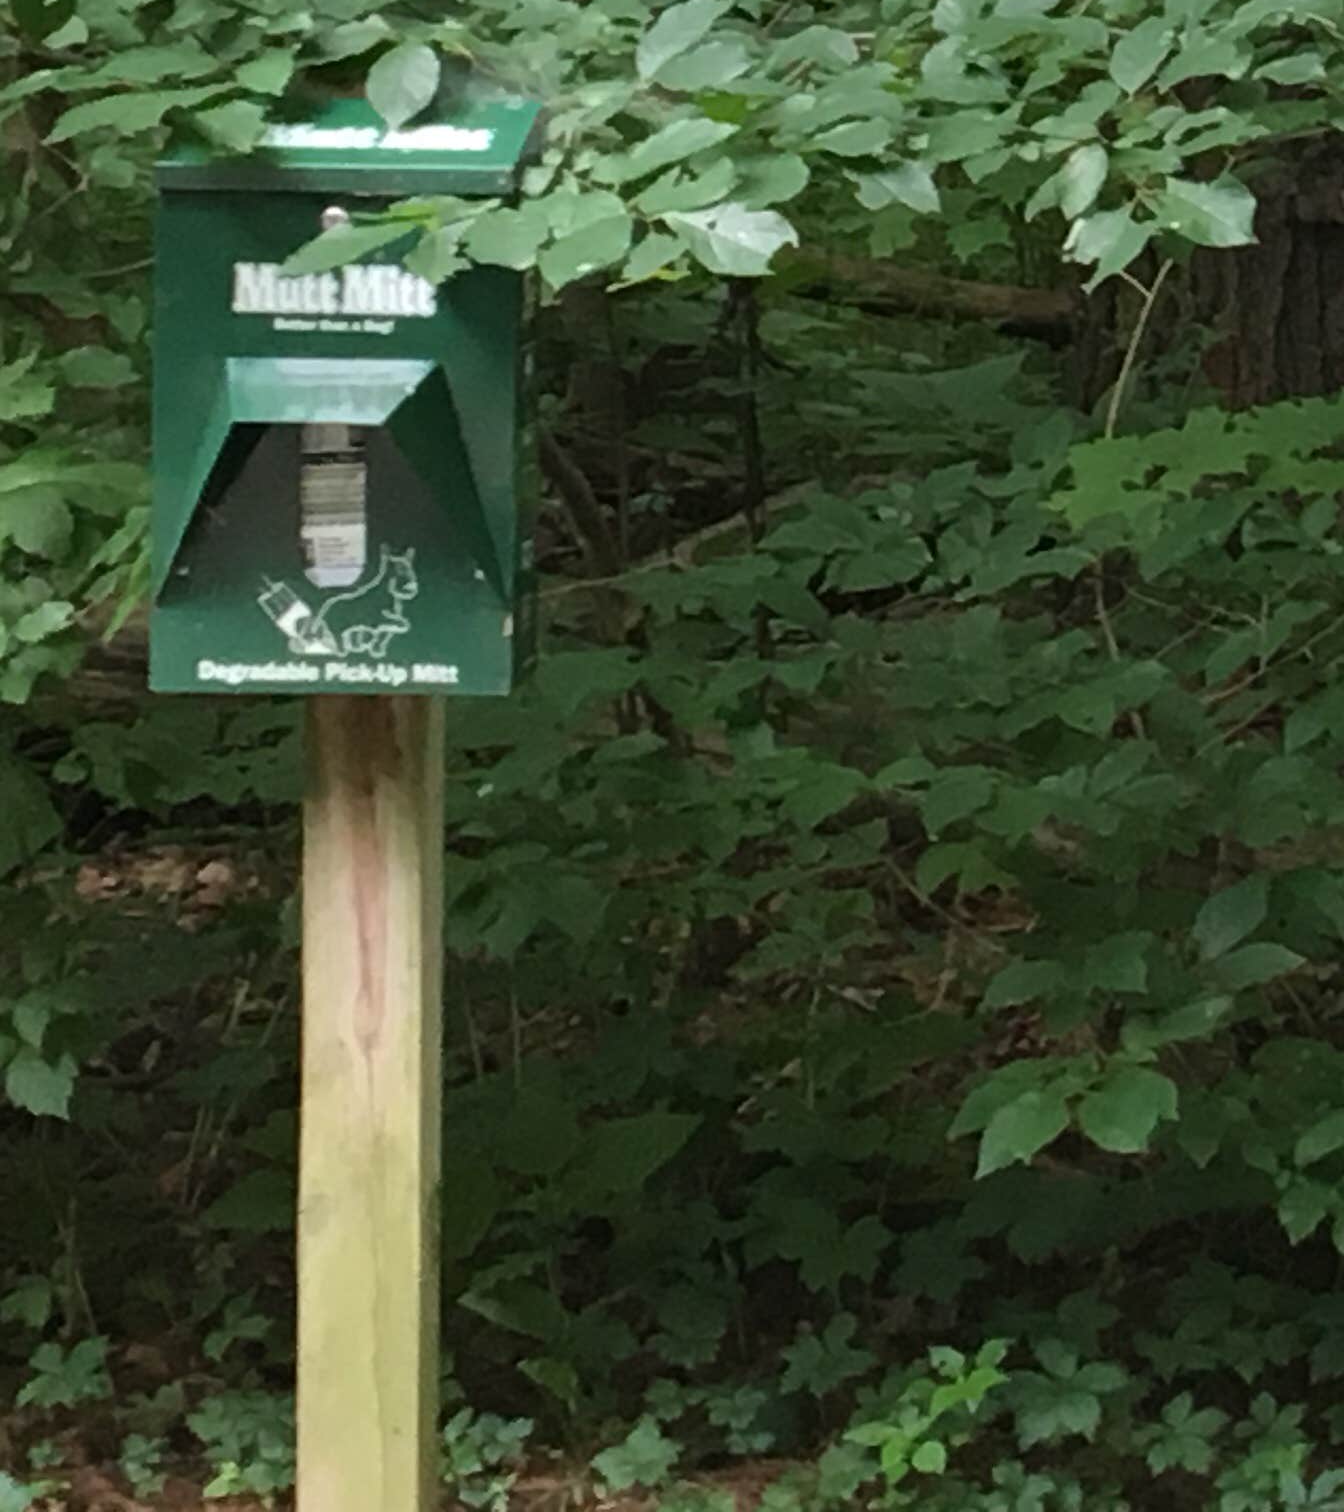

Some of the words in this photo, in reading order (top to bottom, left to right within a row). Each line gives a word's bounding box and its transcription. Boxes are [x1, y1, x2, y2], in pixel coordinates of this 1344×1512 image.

[232, 262, 339, 314] Mutt
[342, 263, 437, 318] Mitt
[197, 659, 320, 685] Degradable
[324, 661, 408, 686] Pick-Up
